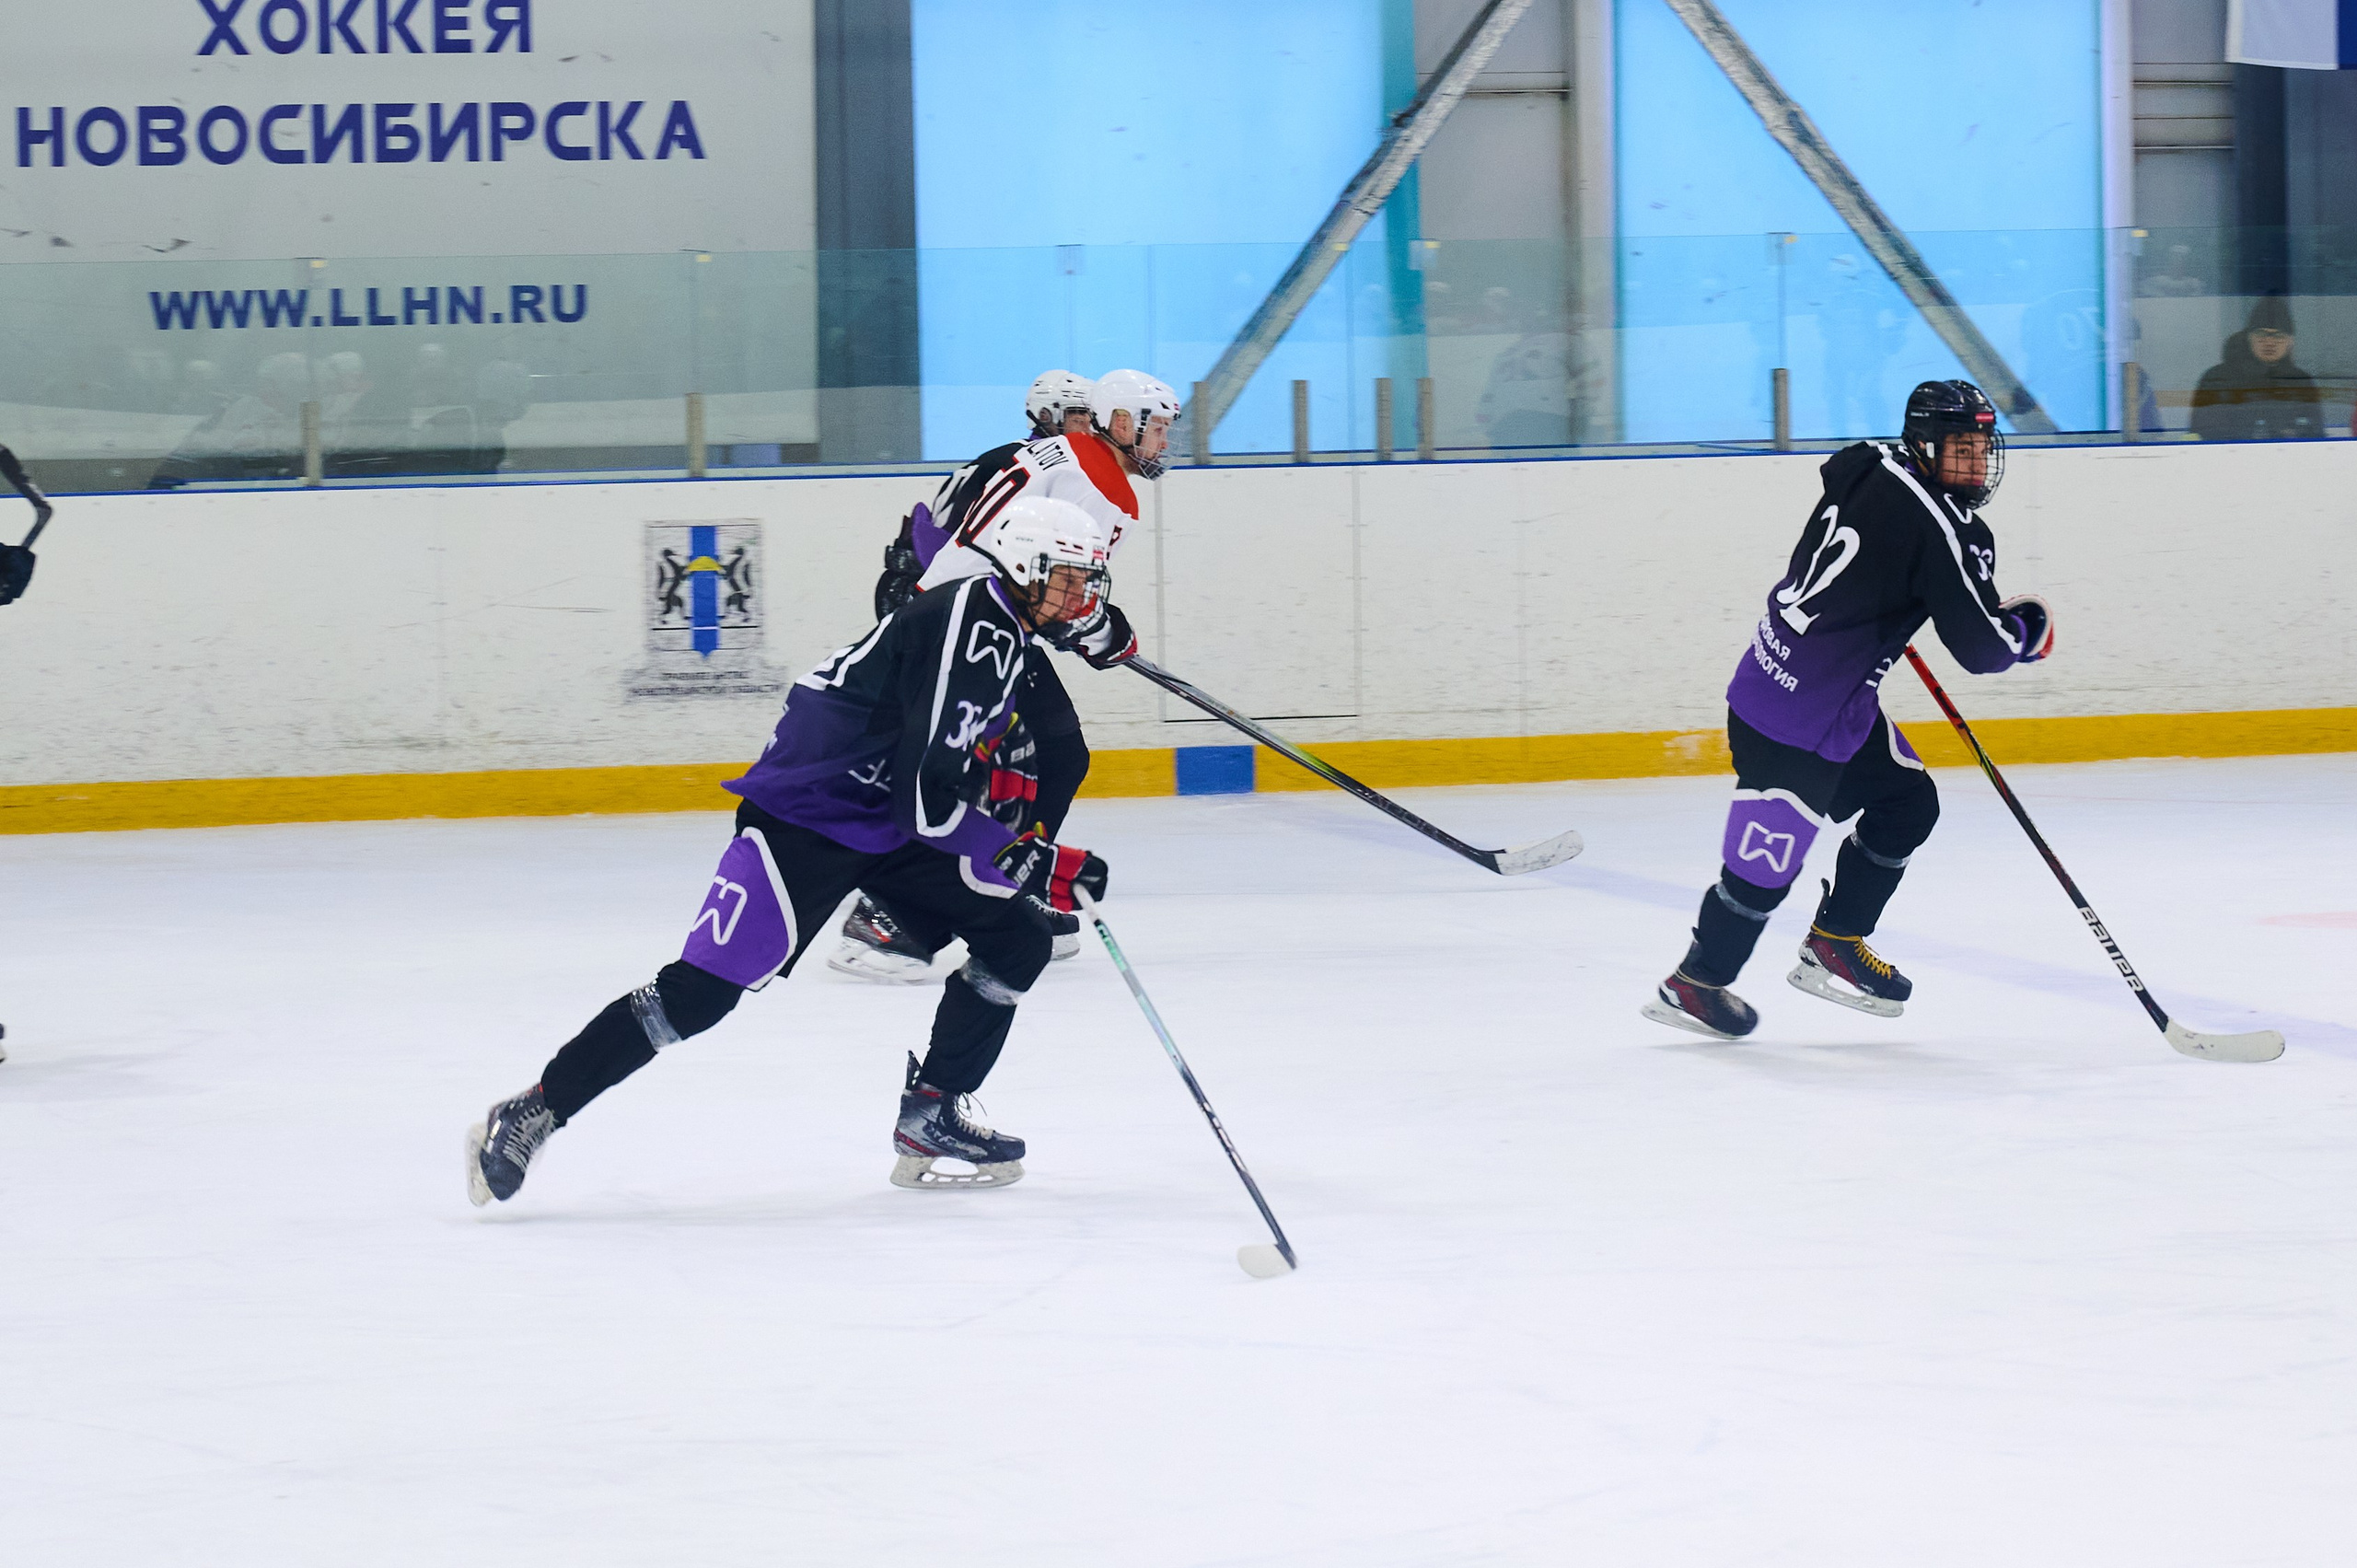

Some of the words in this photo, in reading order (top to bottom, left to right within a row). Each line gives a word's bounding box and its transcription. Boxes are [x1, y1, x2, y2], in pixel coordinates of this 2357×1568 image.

[197, 0, 532, 55] ХОККЕЯ
[17, 100, 706, 167] НОВОСИБИРСКА
[150, 284, 588, 330] WWW.LLHN.RU
